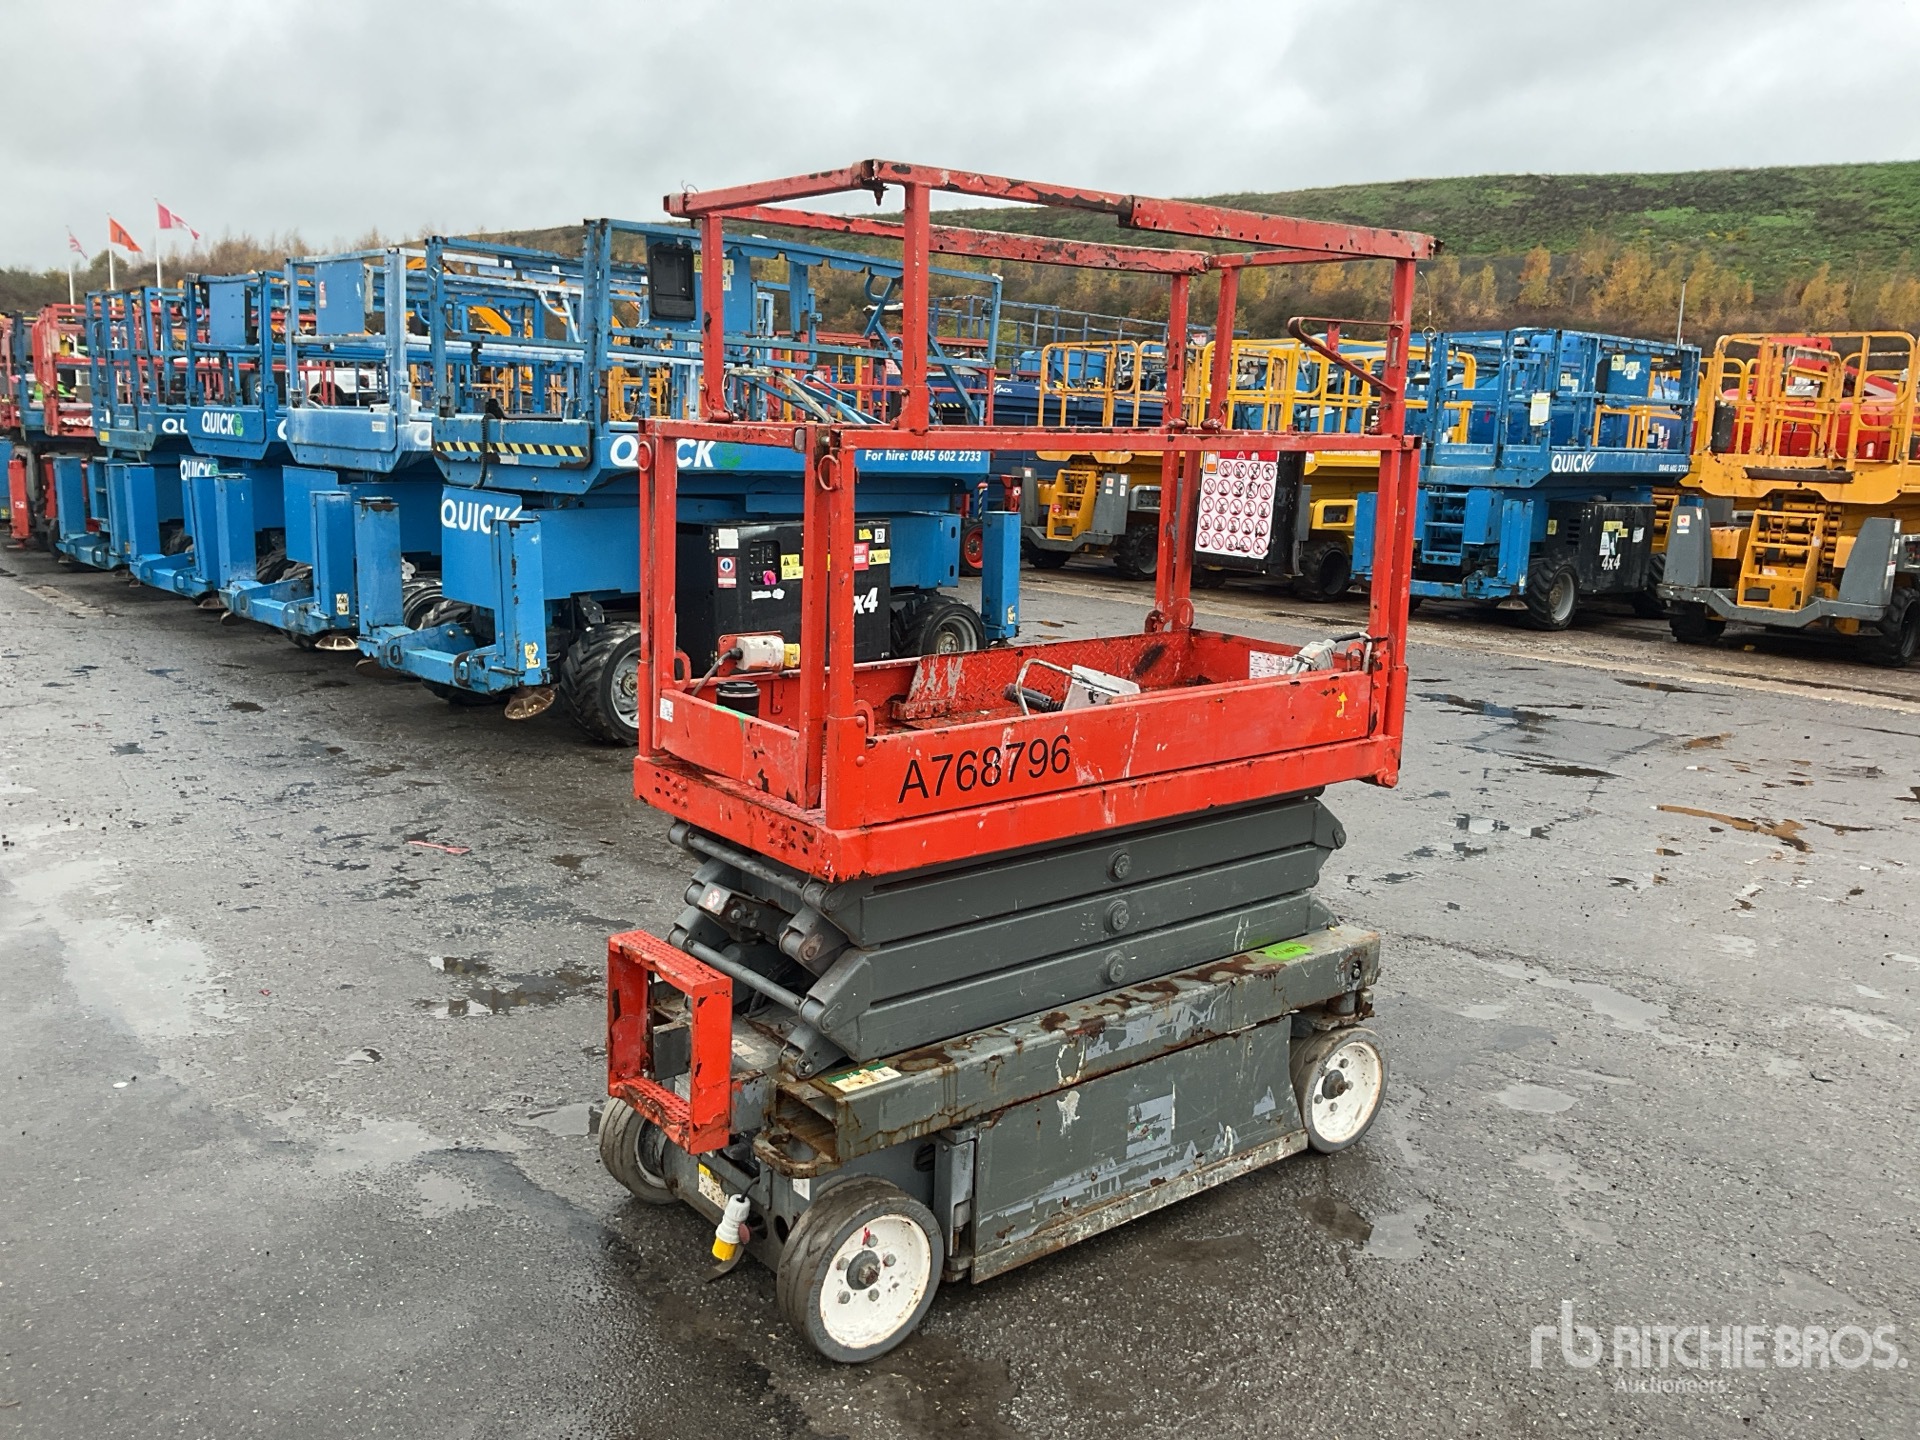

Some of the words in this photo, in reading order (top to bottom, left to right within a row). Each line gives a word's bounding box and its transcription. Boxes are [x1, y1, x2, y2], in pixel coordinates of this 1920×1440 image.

[201, 411, 235, 435] QUICK
[865, 450, 883, 461] For
[885, 450, 908, 461] hire:
[911, 450, 936, 461] 0845
[938, 450, 955, 462] 602
[958, 450, 981, 462] 2733
[1551, 454, 1590, 473] QUICK
[1601, 554, 1621, 571] 4x4
[898, 735, 1071, 804] A768796
